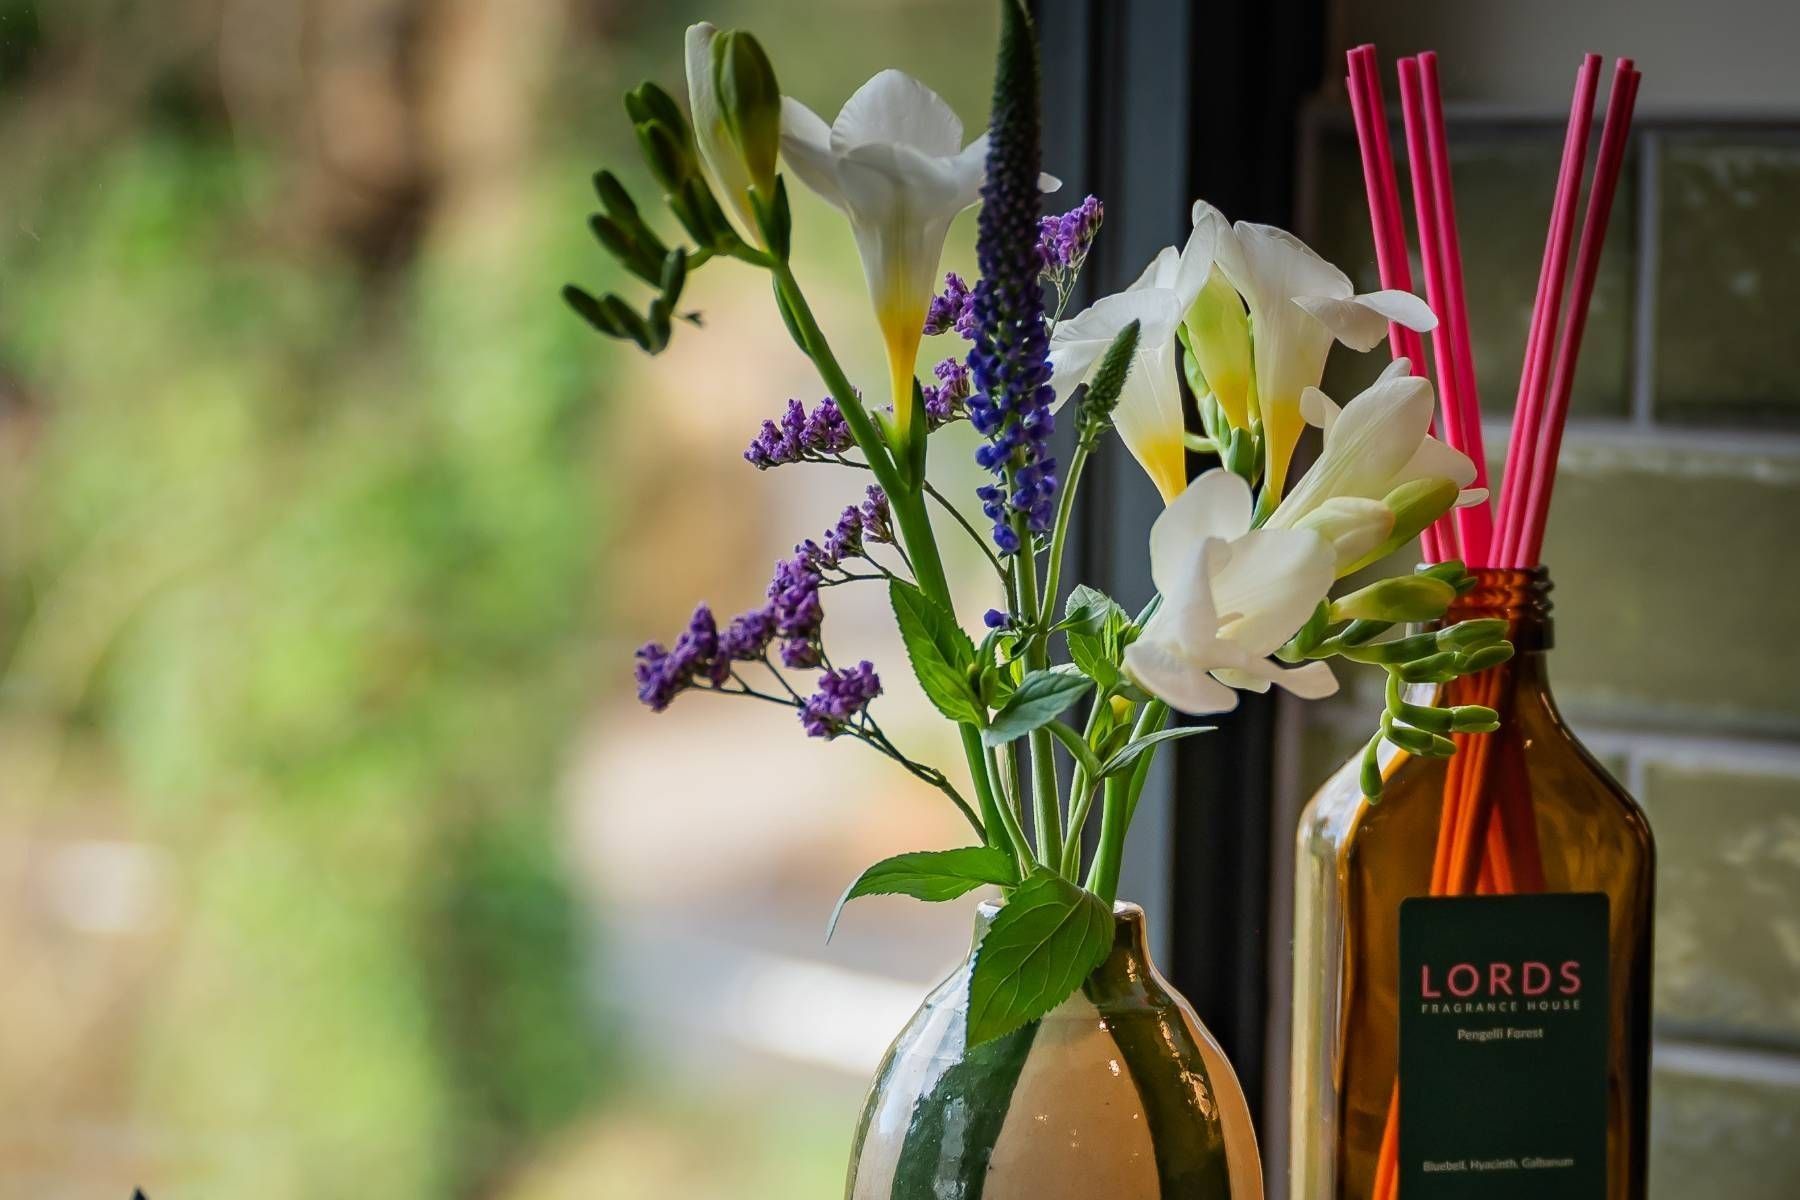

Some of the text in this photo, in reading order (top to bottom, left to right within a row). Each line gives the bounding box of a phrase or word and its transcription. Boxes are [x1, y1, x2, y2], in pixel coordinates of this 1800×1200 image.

[1421, 960, 1581, 997] LORDS
[1421, 999, 1580, 1014] FRAGRANCE HOUSE
[1457, 1028, 1543, 1041] Pengelli Forest
